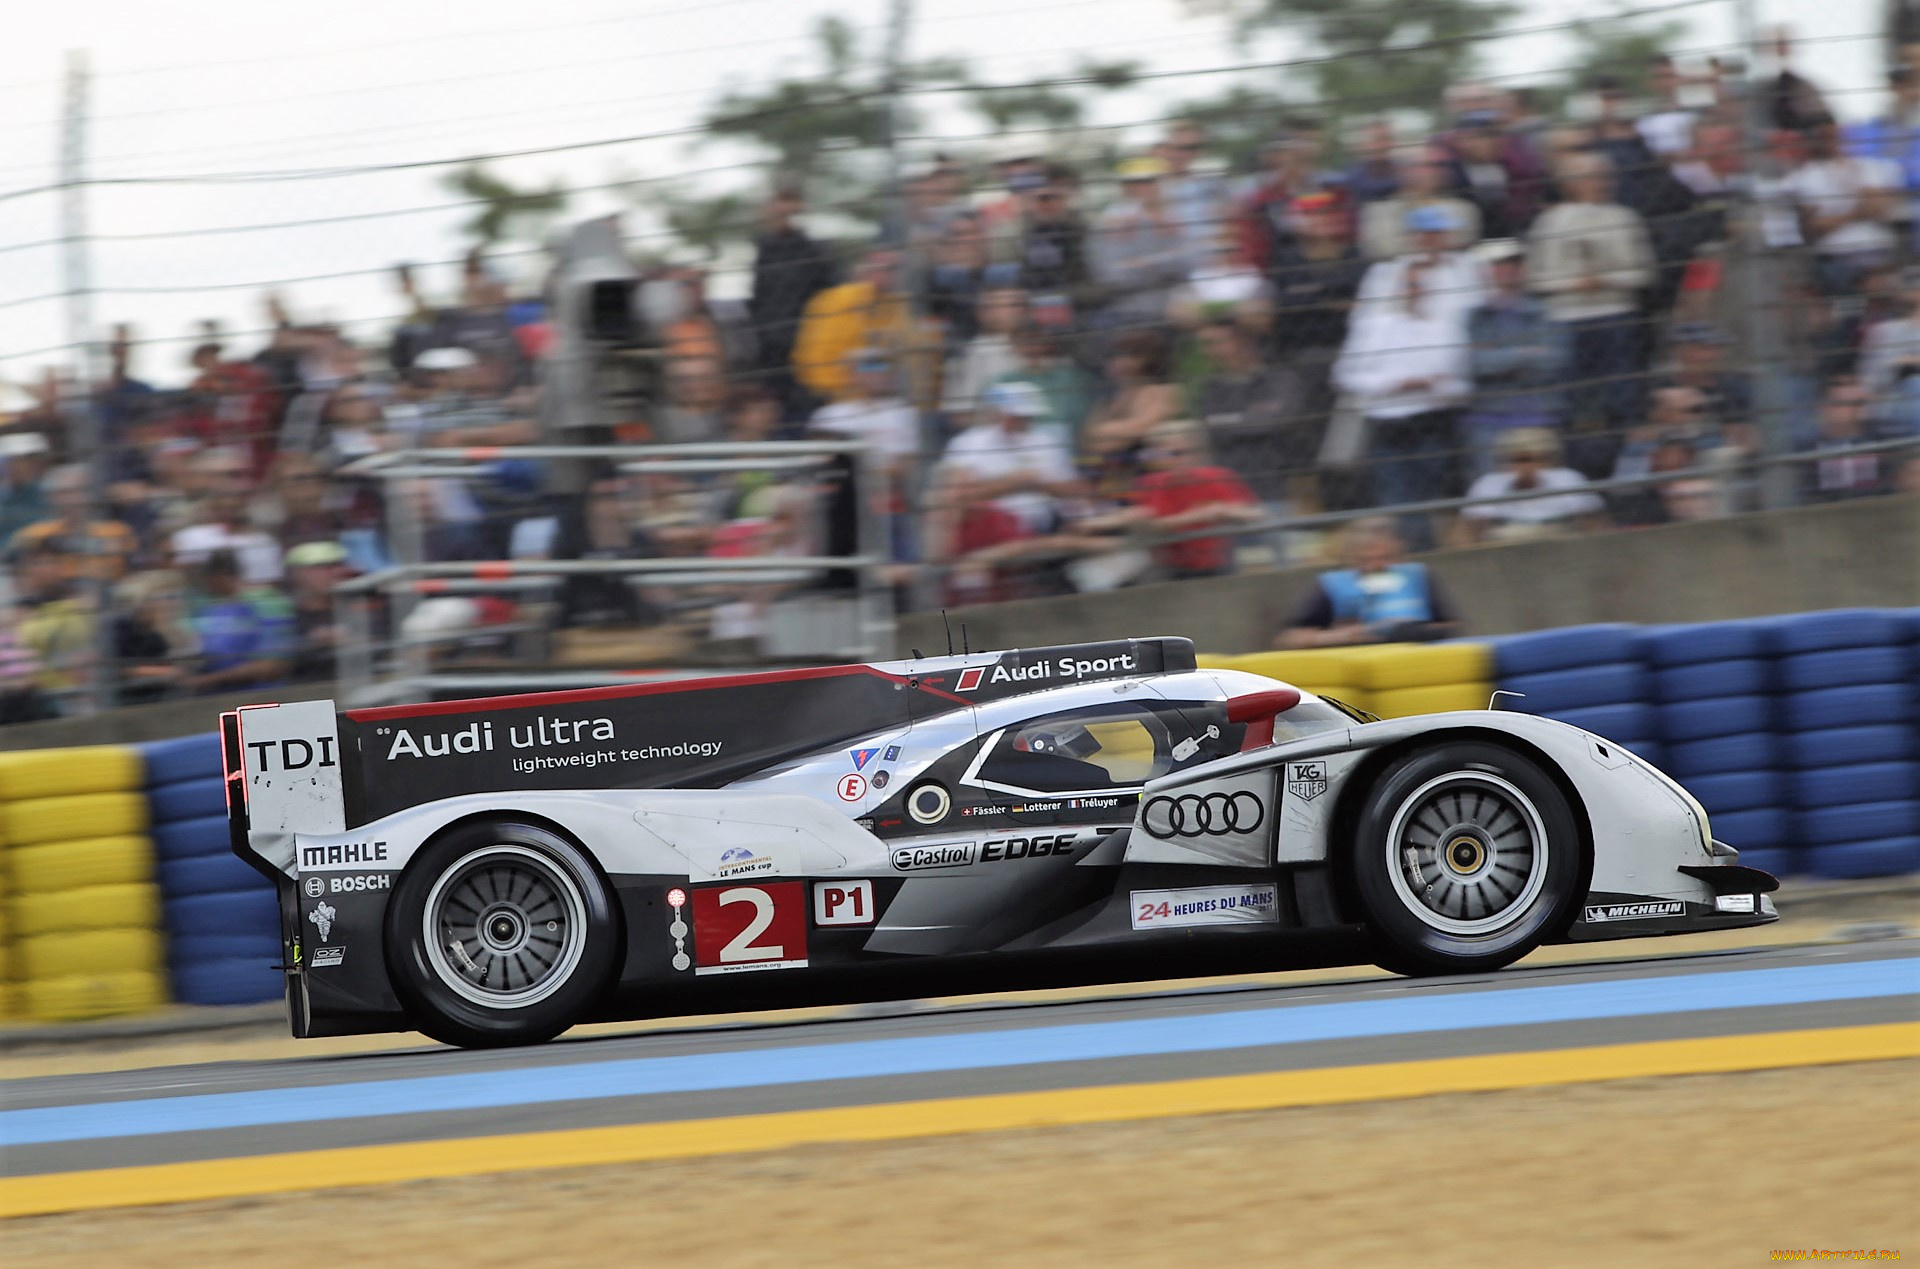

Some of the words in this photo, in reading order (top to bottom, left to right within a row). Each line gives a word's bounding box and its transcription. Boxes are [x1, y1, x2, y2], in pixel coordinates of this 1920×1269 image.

[990, 660, 1050, 684] Audi
[1058, 654, 1133, 679] Sport
[387, 721, 494, 761] Audi
[509, 716, 615, 749] ultra
[247, 736, 336, 772] TDI
[512, 750, 617, 774] lightweight
[620, 741, 723, 762] technology
[1294, 764, 1320, 780] TAG
[845, 779, 859, 797] E
[1291, 782, 1325, 799] HEUER
[972, 806, 1006, 817] Fässler
[1023, 801, 1062, 813] Lotterer
[1080, 798, 1118, 809] Tréluyer
[303, 841, 388, 867] MAHLE
[912, 846, 968, 866] Castrol
[980, 833, 1079, 863] EDGE
[719, 856, 772, 870] INTERCONTINENTAL
[731, 864, 756, 876] MANS
[330, 874, 391, 893] BOSCH
[823, 886, 864, 918] P1
[1137, 901, 1172, 921] 24
[1174, 899, 1216, 916] HEURES
[1220, 897, 1236, 910] DU
[1240, 891, 1273, 907] MANS
[1608, 902, 1682, 917] MICHELIN
[718, 887, 784, 963] 2
[723, 963, 782, 972] www.lemans.org
